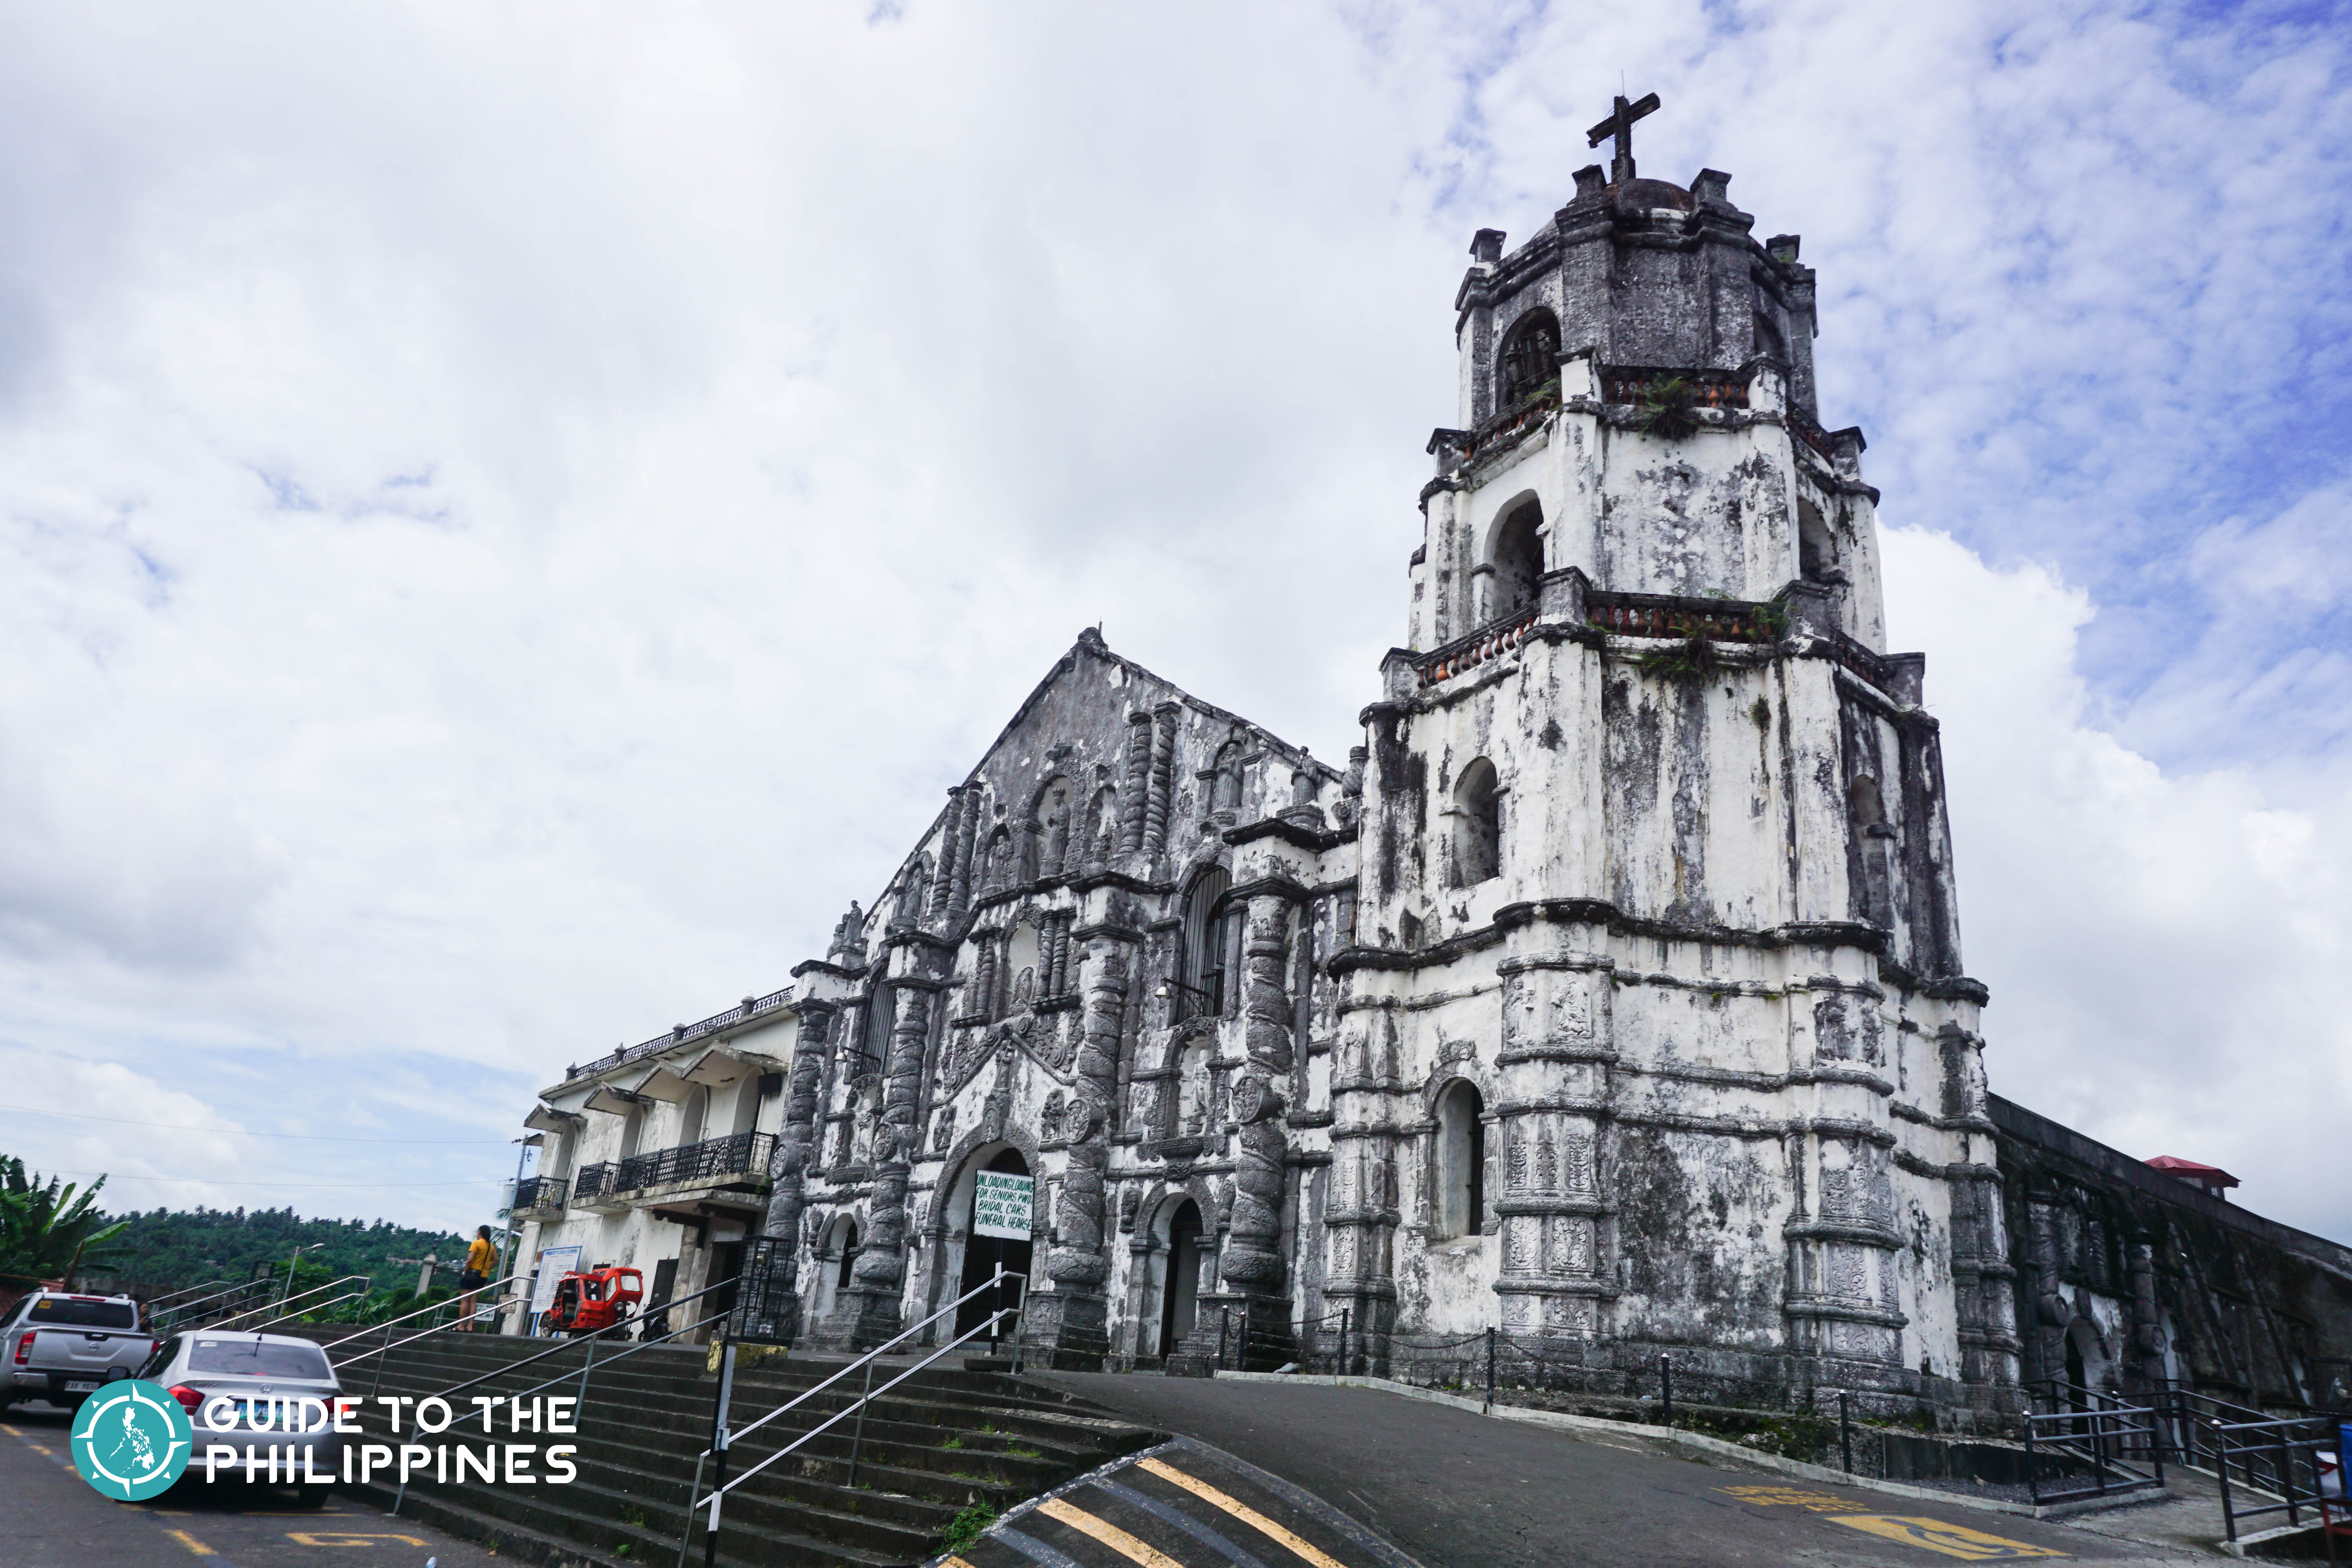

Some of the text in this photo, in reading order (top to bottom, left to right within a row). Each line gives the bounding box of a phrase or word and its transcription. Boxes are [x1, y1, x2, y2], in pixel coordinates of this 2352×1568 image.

[976, 1187, 988, 1198] FOR
[989, 1189, 1016, 1202] SENIORS
[978, 1200, 1026, 1216] BRIDAL CARS
[975, 1212, 1032, 1231] FUNERAL HEARSE
